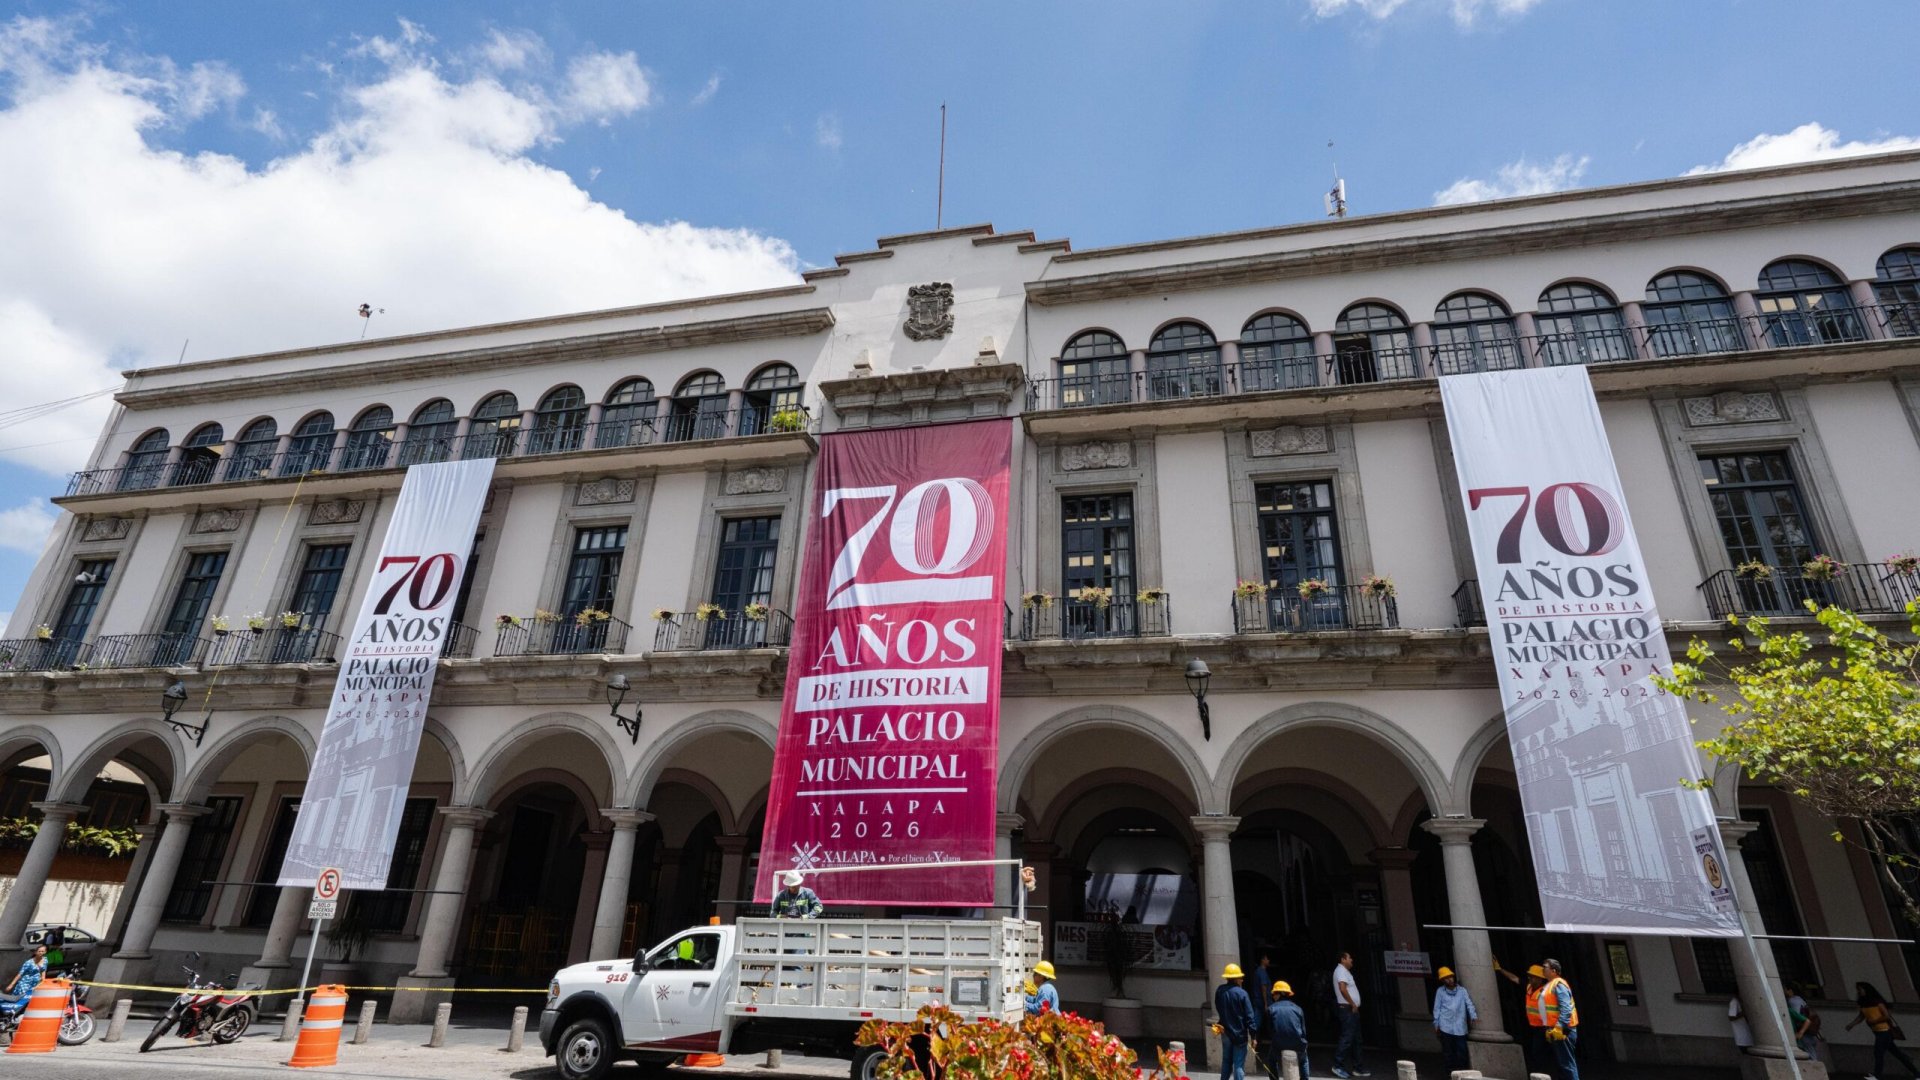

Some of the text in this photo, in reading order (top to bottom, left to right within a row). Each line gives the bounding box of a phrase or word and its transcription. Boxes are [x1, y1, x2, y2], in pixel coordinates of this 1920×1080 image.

[1468, 481, 1625, 565] 70
[822, 478, 995, 608] 70
[373, 552, 463, 615] 70
[1494, 560, 1639, 602] AÑOS
[1498, 601, 1644, 616] DE HISTORIA
[356, 613, 445, 643] AÑOS
[1502, 617, 1650, 644] PALACIO
[353, 644, 434, 654] DE HISTORIA
[811, 613, 976, 670] AÑOS
[1506, 641, 1657, 664] MUNICIPAL
[347, 656, 430, 676] PALACIO
[1510, 663, 1662, 680] XALAPA
[342, 676, 426, 691] MUNICIPAL
[812, 676, 970, 702] DE HISTORIA
[341, 692, 423, 703] XALAPA
[807, 710, 966, 746] PALACIO
[799, 754, 967, 783] MUNICIPAL
[810, 799, 945, 816] XALAPA
[830, 821, 920, 839] 2026
[823, 850, 877, 863] XALAPA
[888, 854, 900, 863] Por
[902, 853, 908, 862] el
[909, 853, 924, 863] bien
[1057, 925, 1086, 943] MES
[606, 972, 628, 984] 918
